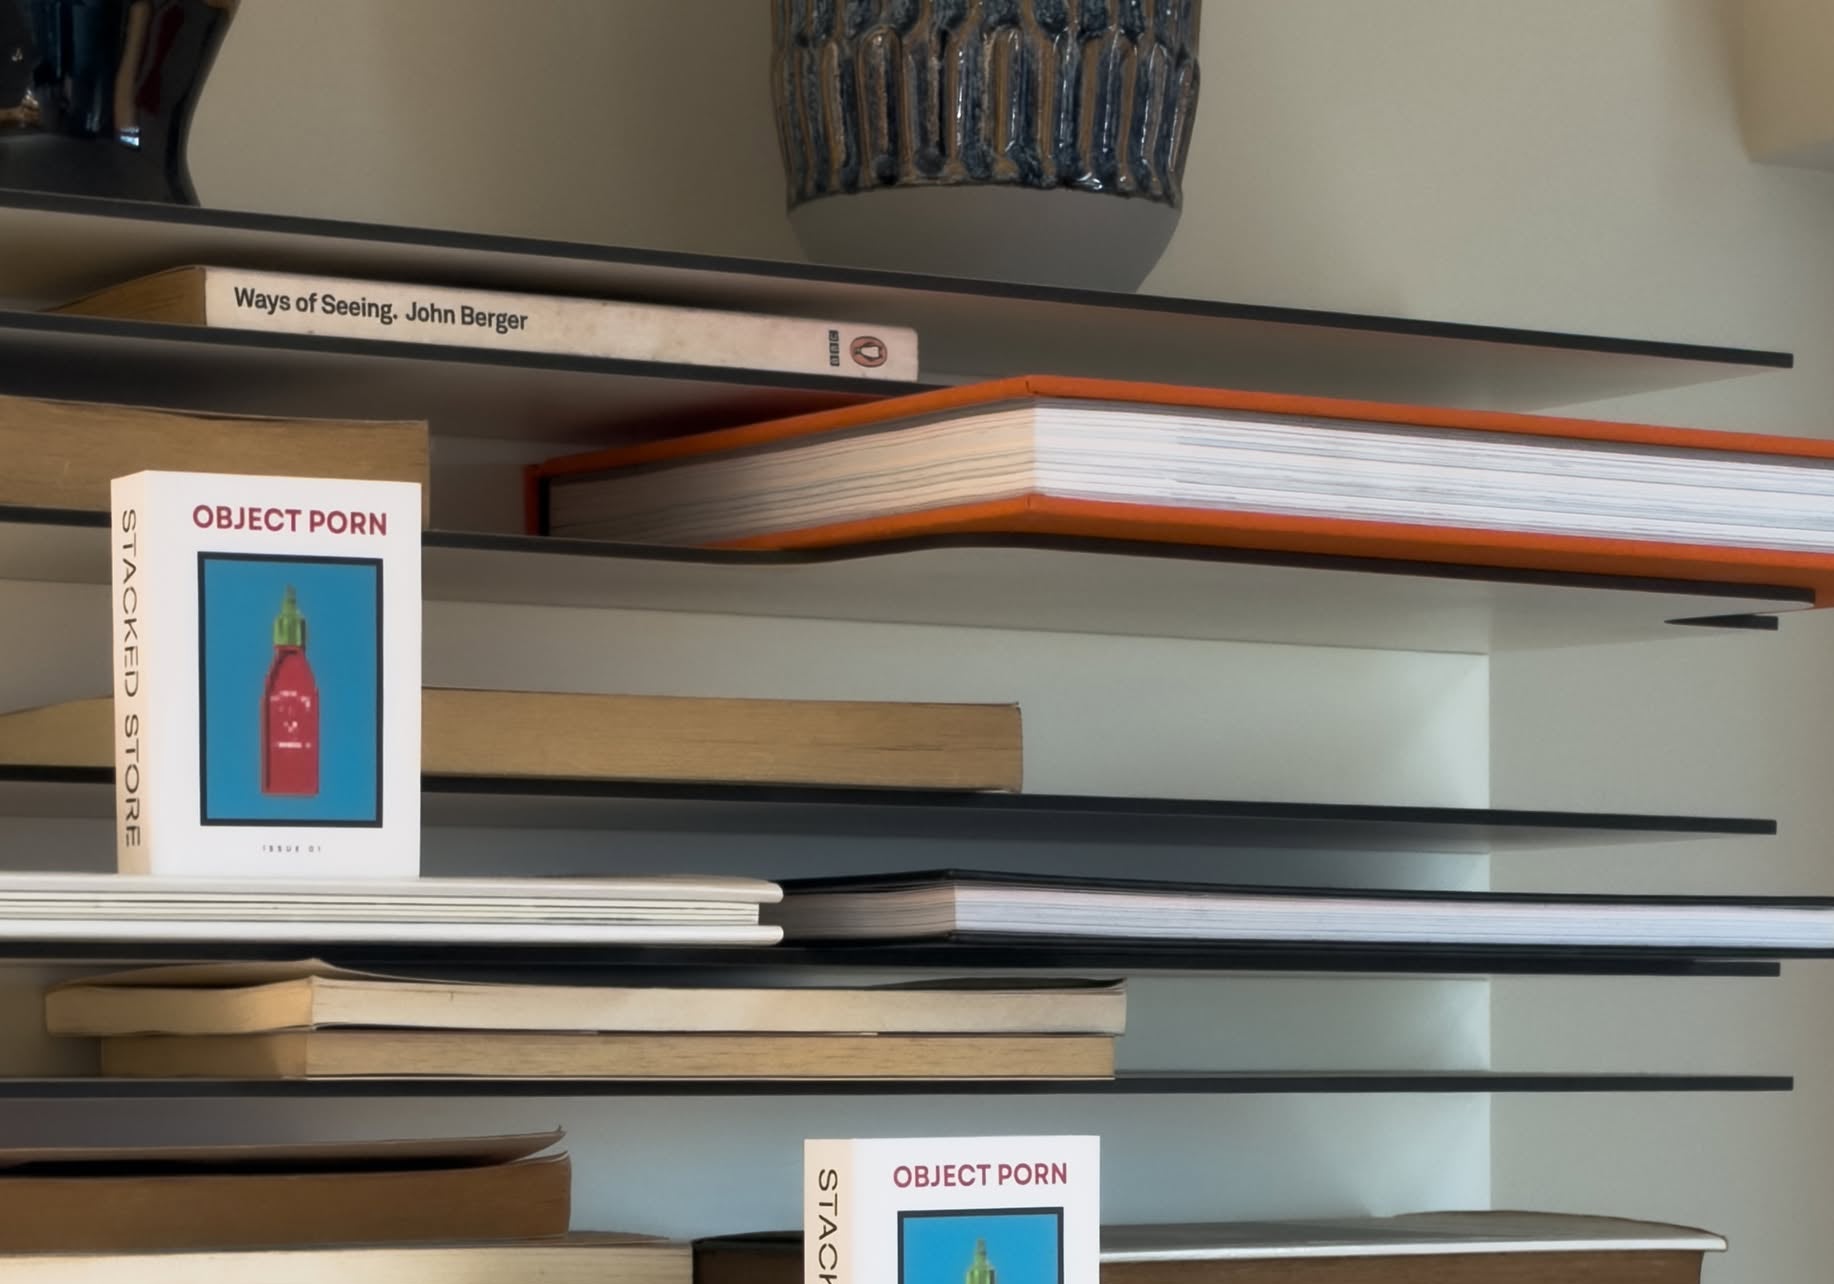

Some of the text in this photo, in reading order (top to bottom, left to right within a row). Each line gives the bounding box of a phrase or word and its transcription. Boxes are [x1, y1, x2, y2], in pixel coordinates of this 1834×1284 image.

[234, 286, 529, 334] Ways of Seeing. John Berger
[192, 504, 388, 536] OBJECT PORN
[122, 508, 141, 847] STACKED STORE
[262, 844, 300, 853] ISSUE
[893, 1162, 1068, 1188] OBJECT PORN
